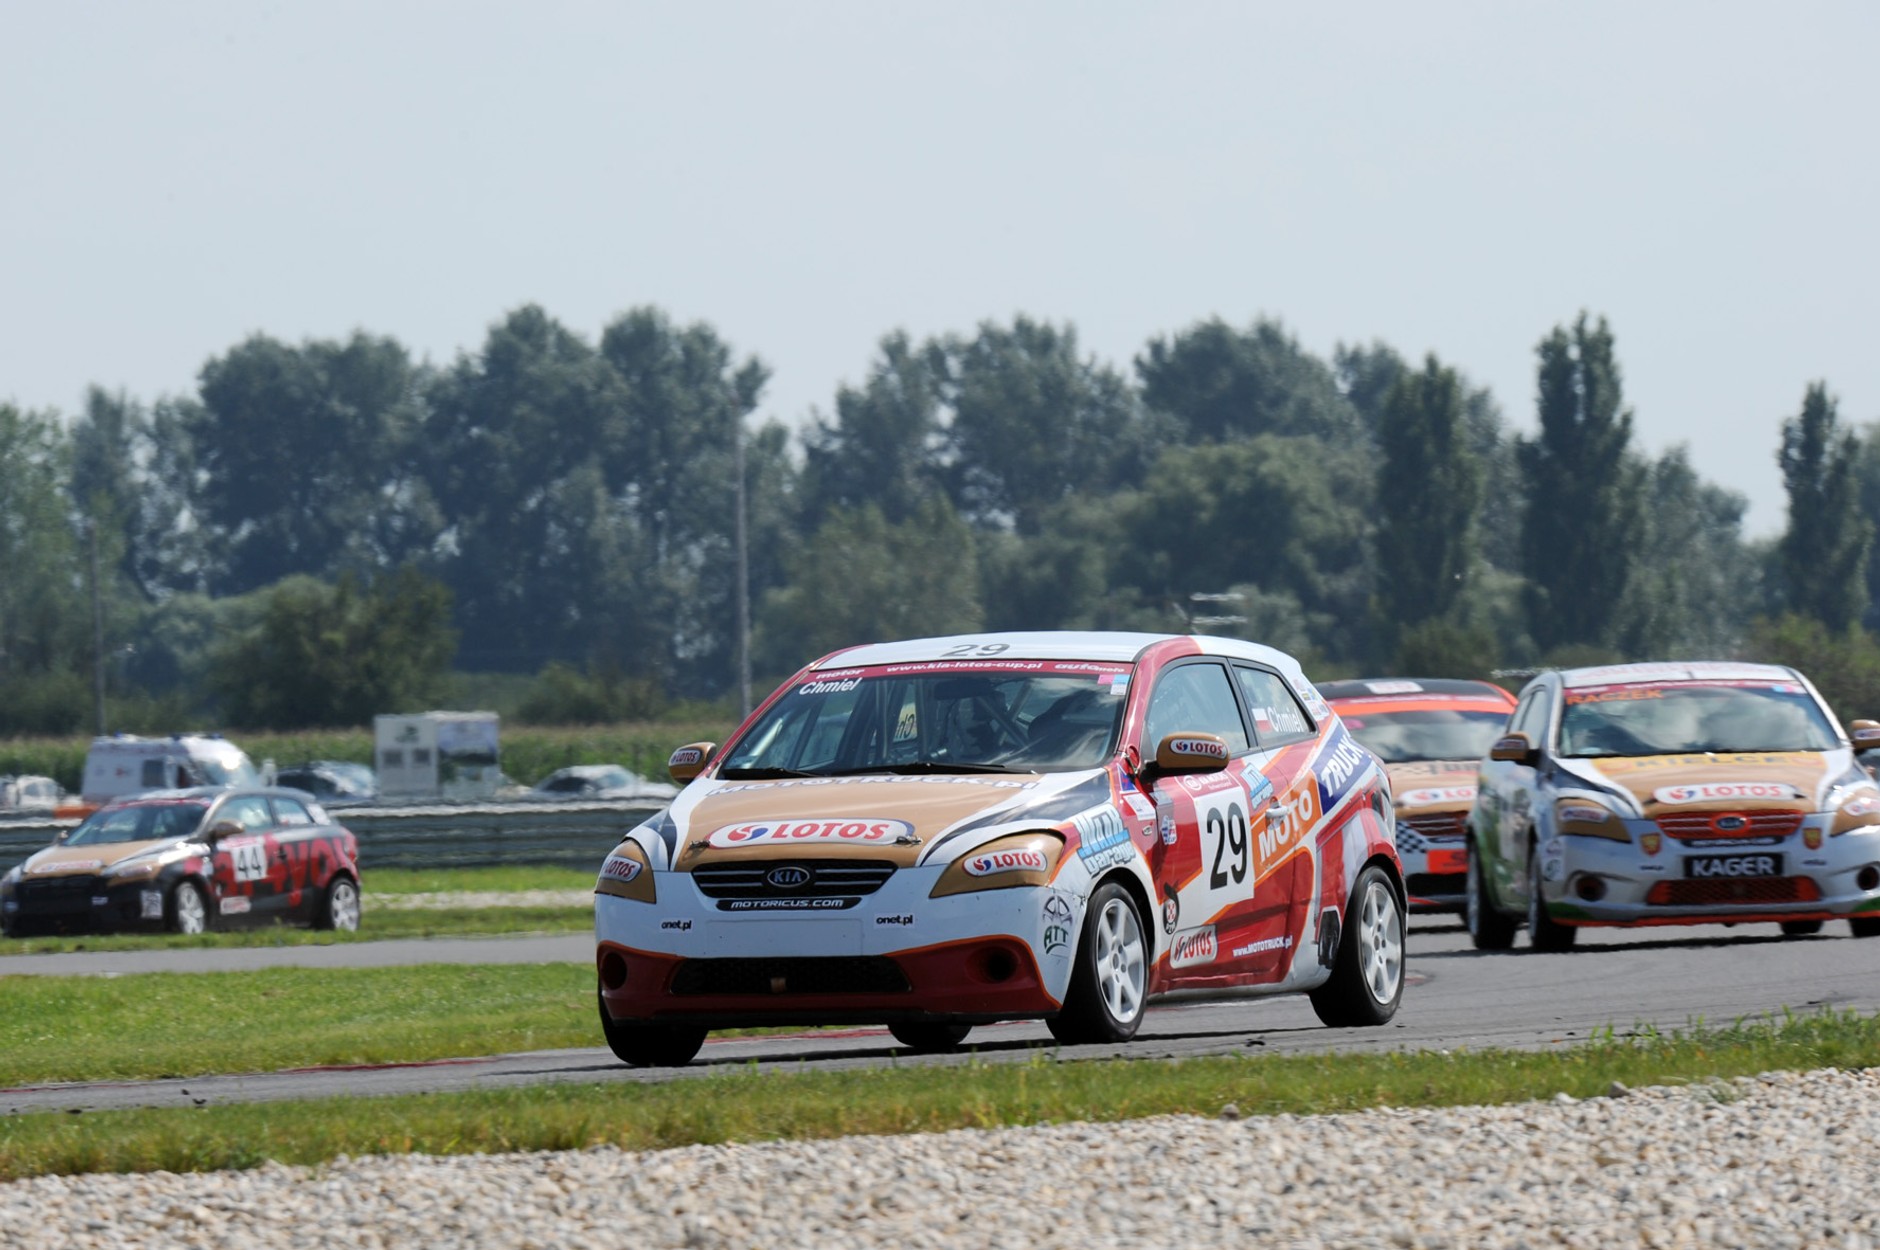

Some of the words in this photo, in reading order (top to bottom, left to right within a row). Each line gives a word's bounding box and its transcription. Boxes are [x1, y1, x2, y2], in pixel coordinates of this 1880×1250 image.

[940, 643, 1010, 657] 29
[816, 669, 865, 679] motor
[886, 661, 1043, 673] www.kia-lotos-cup.pl
[798, 677, 863, 695] Chmiel
[1266, 705, 1304, 733] Chmiel
[1189, 741, 1223, 755] LOTOS
[1258, 789, 1314, 863] MOTO
[1320, 733, 1364, 798] TRUCK
[1703, 785, 1783, 797] LOTOS
[772, 822, 890, 840] LOTOS
[1206, 802, 1248, 890] 29
[237, 847, 263, 879] 44
[604, 859, 637, 878] LOTOS
[993, 852, 1041, 868] LOTOS
[1692, 856, 1774, 876] KAGER
[773, 870, 802, 883] KIA
[730, 899, 844, 909] MOTORICUS.COM
[661, 919, 692, 932] onet.pl
[876, 914, 913, 926] onet.pl
[1183, 930, 1213, 959] LOTOS
[1232, 935, 1293, 958] www.MOTOTRUCK.pl
